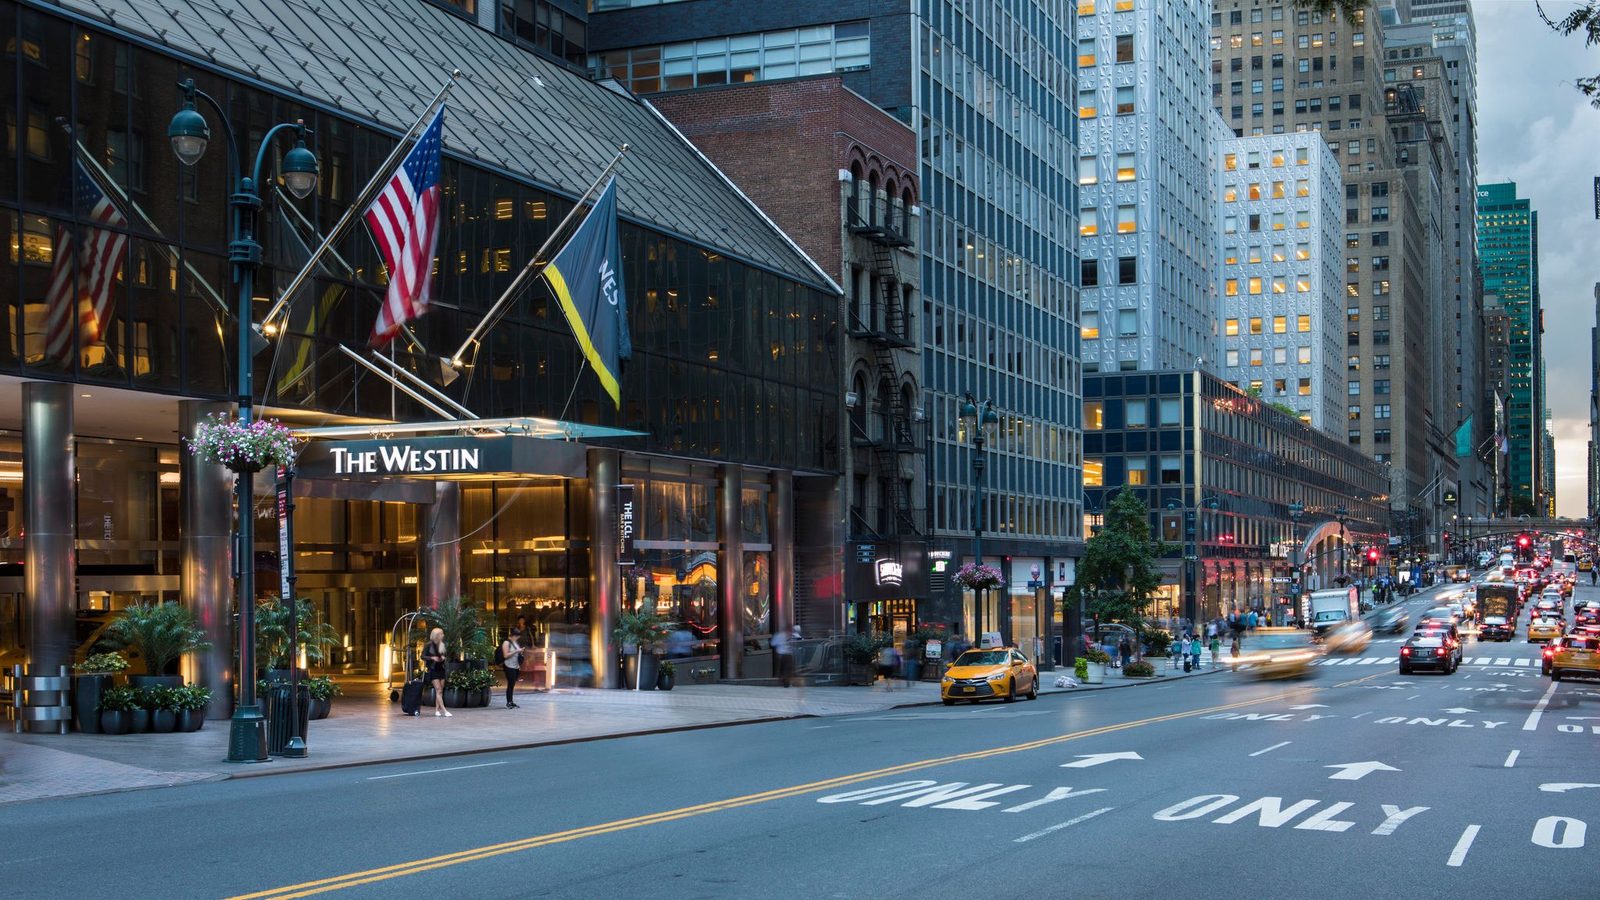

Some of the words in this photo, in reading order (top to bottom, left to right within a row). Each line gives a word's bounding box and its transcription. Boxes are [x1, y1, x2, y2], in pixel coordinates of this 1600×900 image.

[330, 447, 377, 474] THE
[624, 501, 632, 520] THE
[1199, 712, 1340, 722] ONLY
[1373, 716, 1508, 729] ONLY
[816, 780, 1108, 813] ONLY
[1152, 793, 1431, 836] ONLY
[1531, 815, 1588, 849] O
